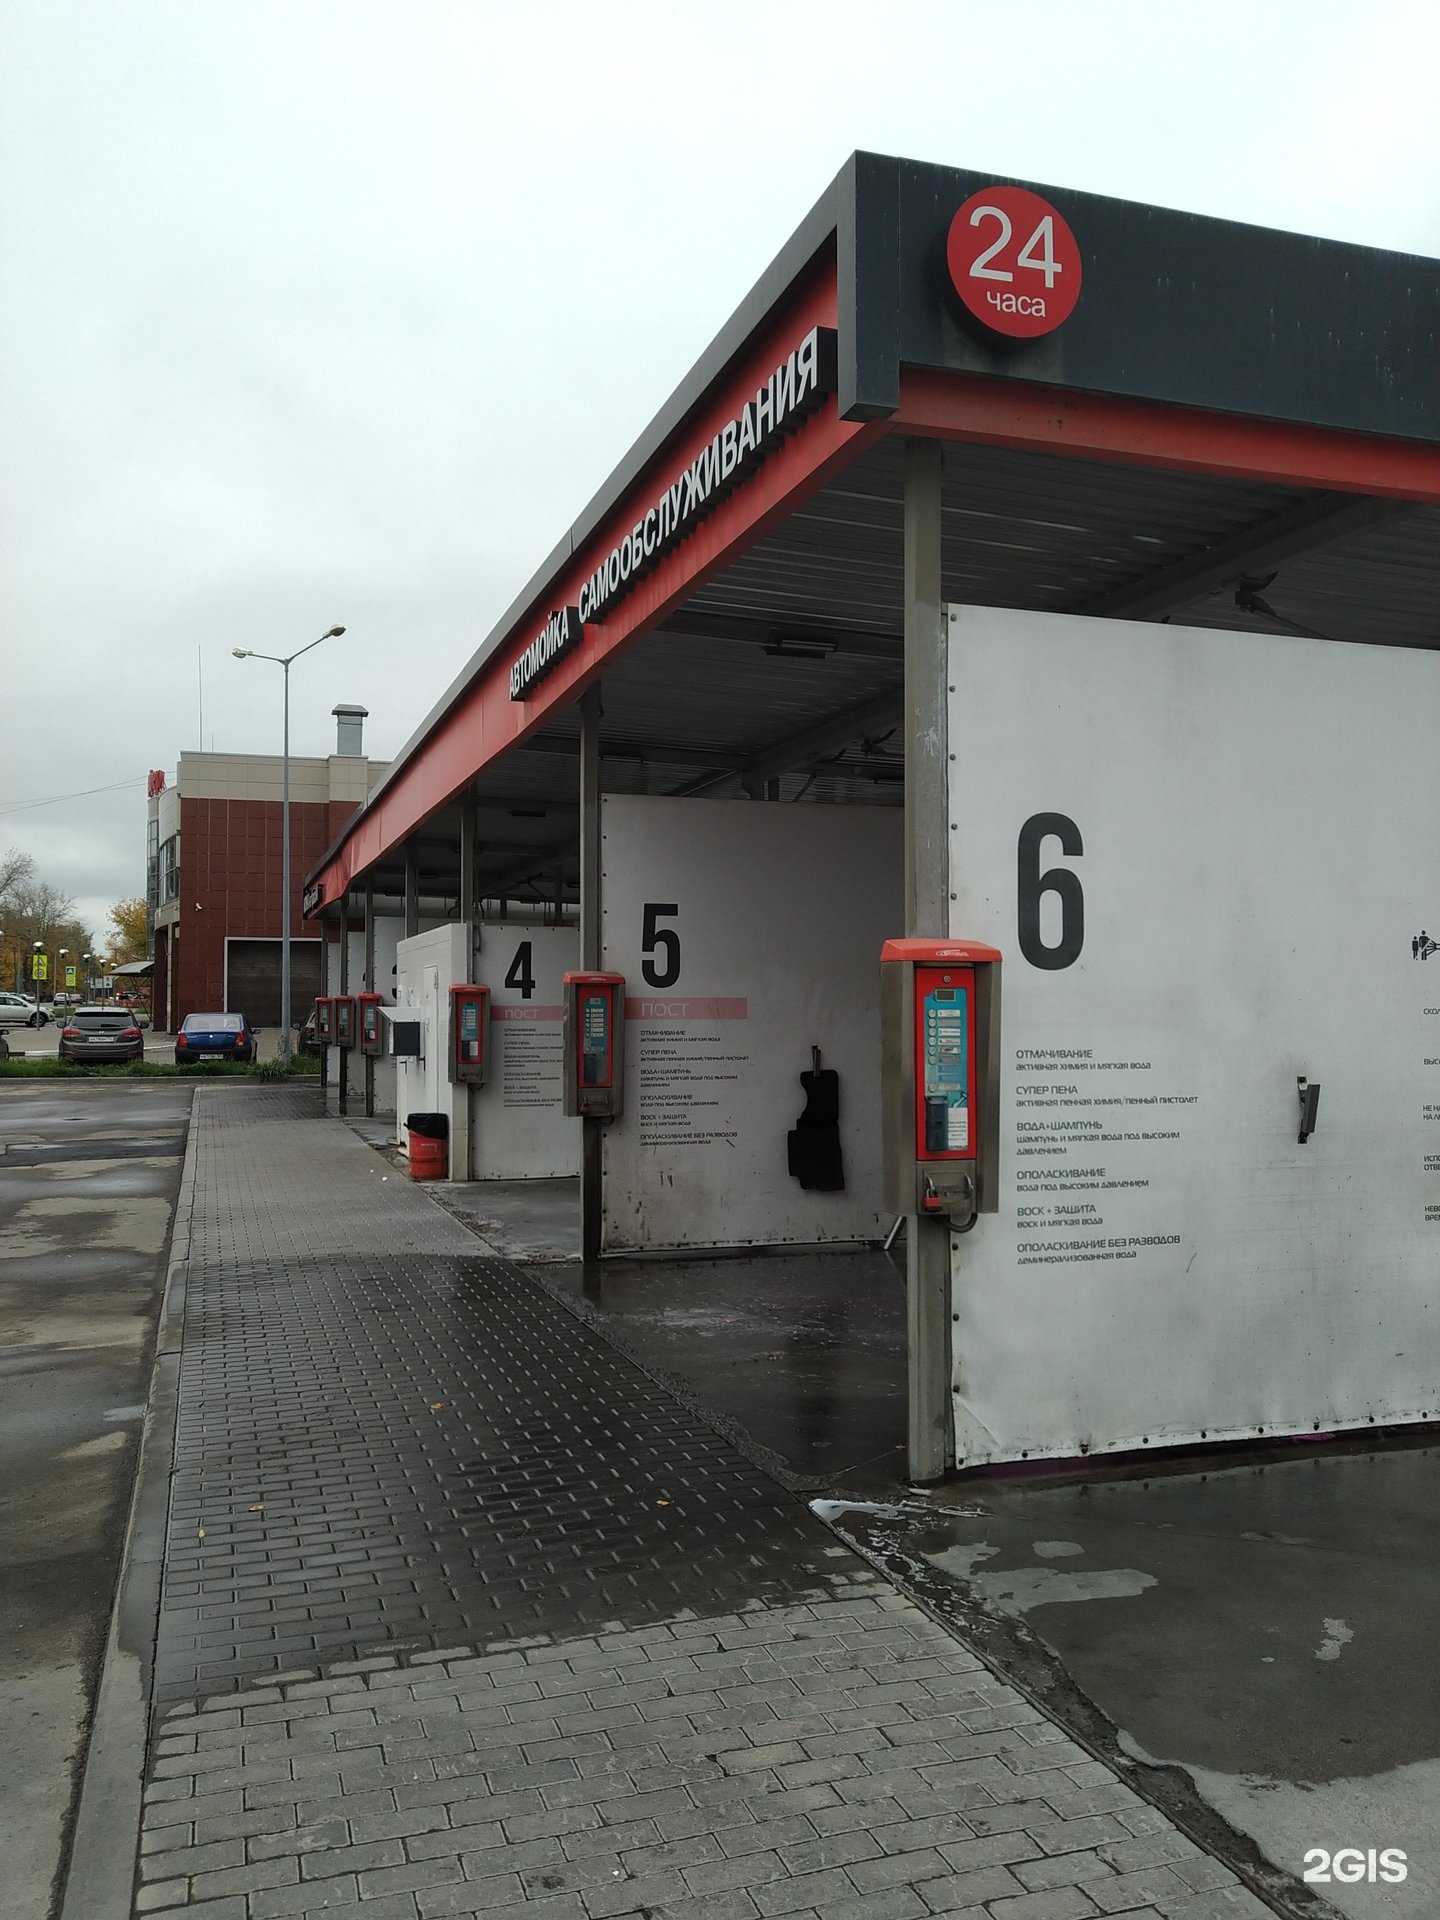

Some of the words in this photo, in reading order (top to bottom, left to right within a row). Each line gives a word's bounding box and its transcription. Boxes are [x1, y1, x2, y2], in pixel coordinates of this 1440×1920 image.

[969, 205, 1062, 289] 24
[986, 289, 1046, 318] часа
[509, 605, 569, 699] АВТОМОЙКА
[578, 327, 818, 624] САМООБСЛУЖИВАНИЯ
[1017, 811, 1085, 971] 6
[641, 903, 681, 989] 5
[504, 941, 536, 1000] 4
[504, 1008, 539, 1020] ПОСТ
[641, 1003, 689, 1017] ПОСТ
[1016, 1050, 1093, 1059] ОТМАЧИВАНИЕ
[1016, 1063, 1058, 1071] активная
[1097, 1062, 1128, 1070] мягкая
[1130, 1062, 1151, 1070] вода
[1016, 1086, 1049, 1095] СУПЕР
[1051, 1085, 1078, 1095] ПЕНА
[1059, 1099, 1092, 1107] пенная
[1159, 1096, 1198, 1104] пистолет
[1016, 1135, 1058, 1144] шампунь
[1067, 1134, 1100, 1142] мягкая
[1101, 1133, 1123, 1141] вода
[1124, 1132, 1141, 1141] под
[1142, 1131, 1180, 1140] высоким
[1016, 1147, 1067, 1156] давлением
[1016, 1168, 1106, 1180] ОПОЛАСКИВАНИЕ
[1017, 1184, 1039, 1192] вода
[1040, 1184, 1058, 1192] под
[1059, 1182, 1099, 1191] высоким
[1101, 1180, 1149, 1189] давлением
[1017, 1207, 1045, 1216] ВОСК
[1054, 1204, 1097, 1215] ЗАЩИТА
[1017, 1220, 1038, 1229] воск
[1048, 1219, 1080, 1227] мягкая
[1081, 1217, 1103, 1226] вода
[1017, 1239, 1106, 1253] ОПОЛАСКИВАНИЕ
[1108, 1238, 1127, 1248] БЕЗ
[1128, 1235, 1181, 1246] РАЗВОДОВ
[1116, 1251, 1137, 1260] вода
